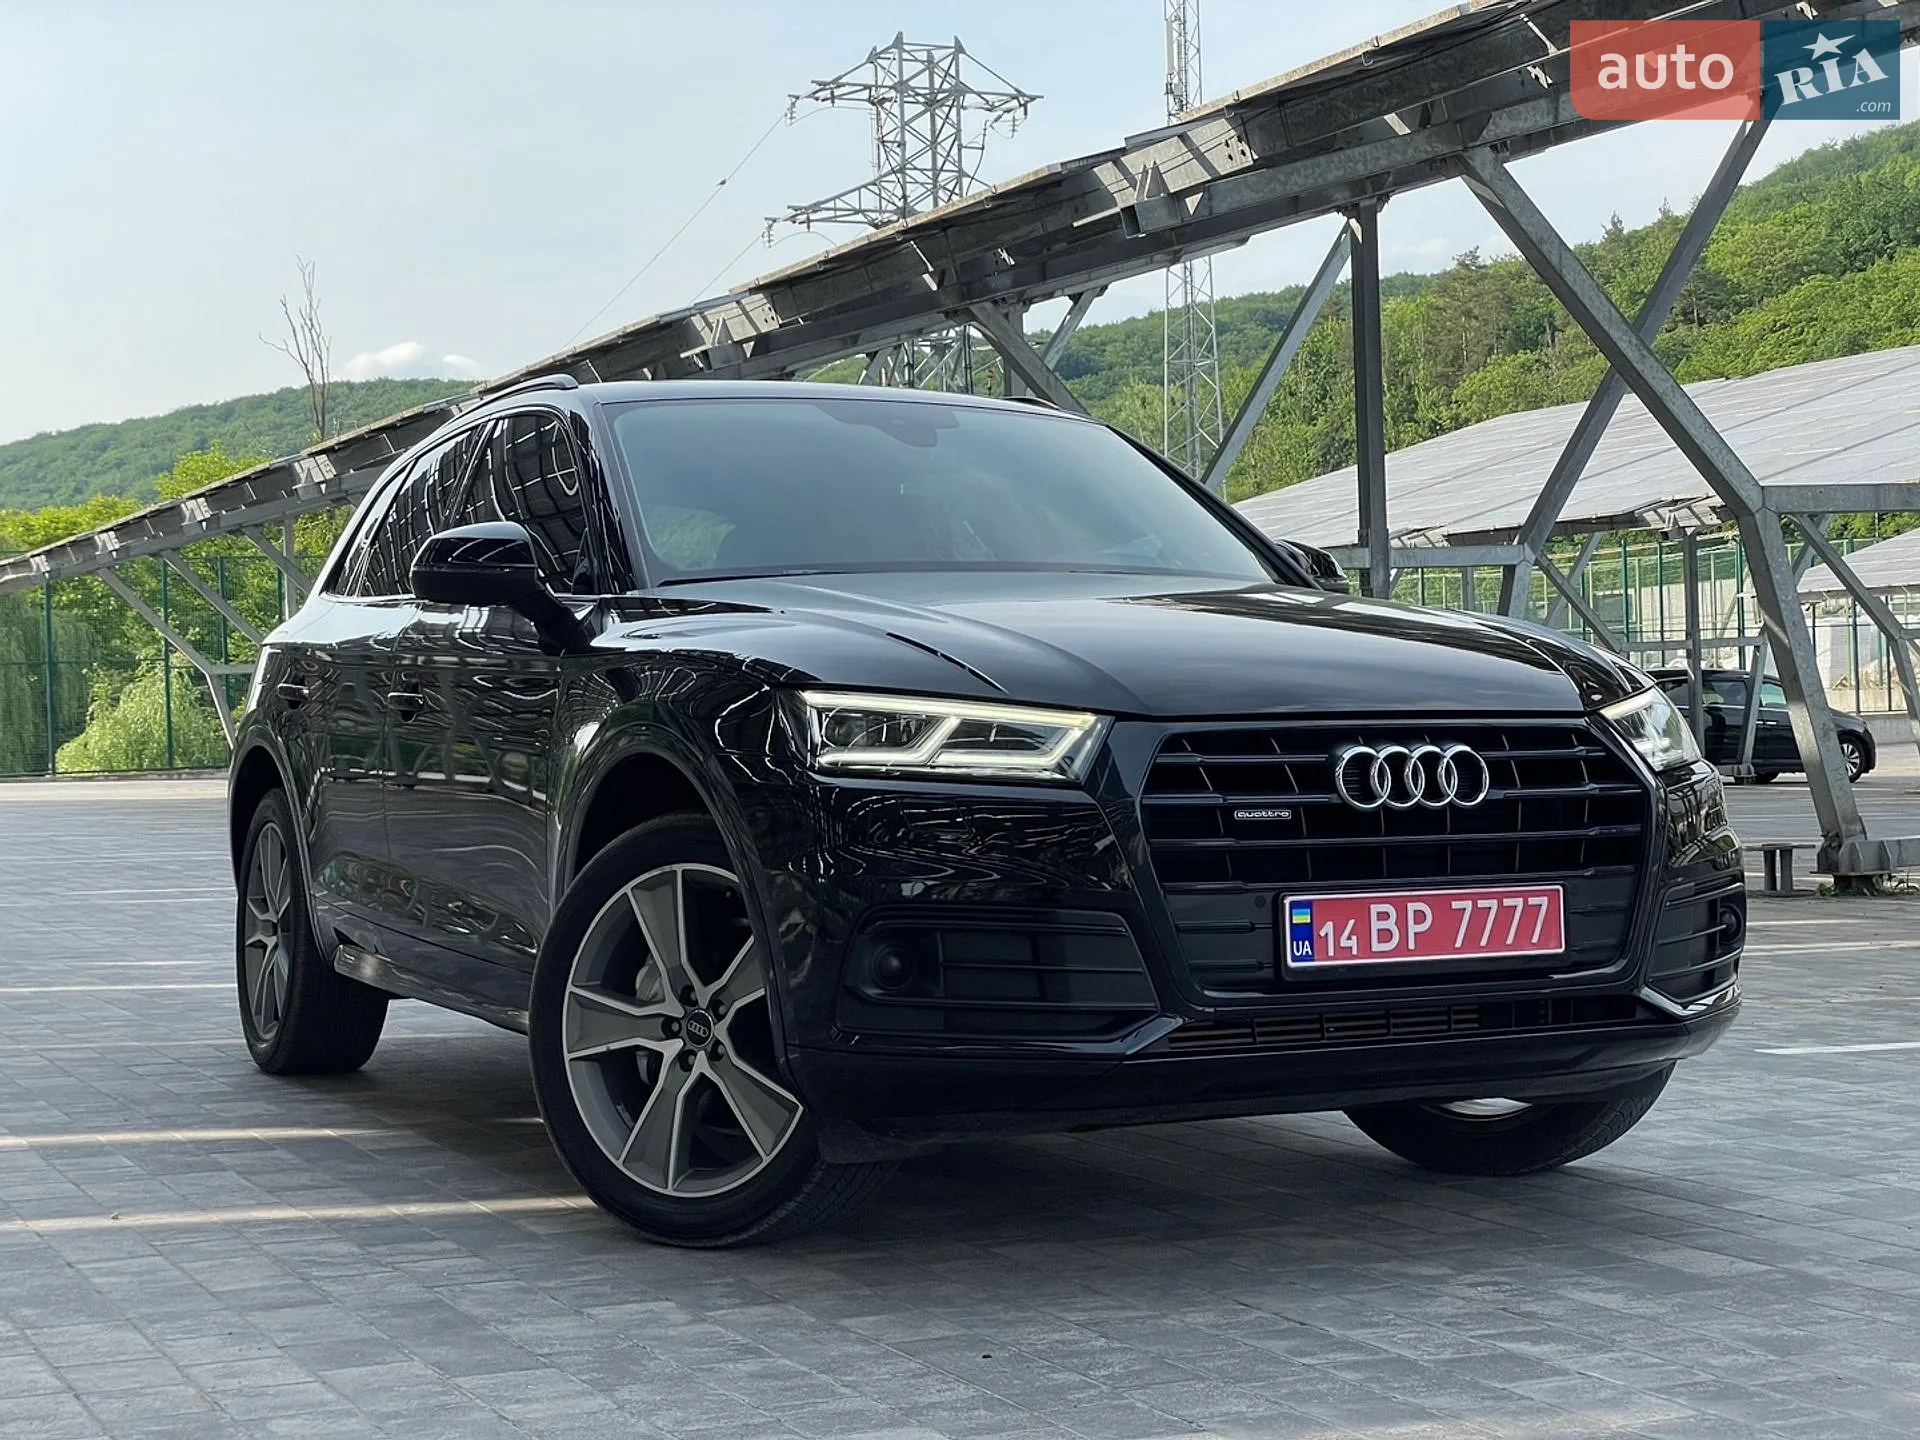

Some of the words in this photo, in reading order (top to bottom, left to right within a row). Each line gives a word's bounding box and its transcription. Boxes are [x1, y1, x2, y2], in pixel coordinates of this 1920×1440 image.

[1237, 811, 1290, 819] quattro
[1293, 940, 1313, 957] UA
[1318, 918, 1358, 957] 14
[1369, 901, 1434, 952] BP
[1451, 896, 1549, 949] 7777
